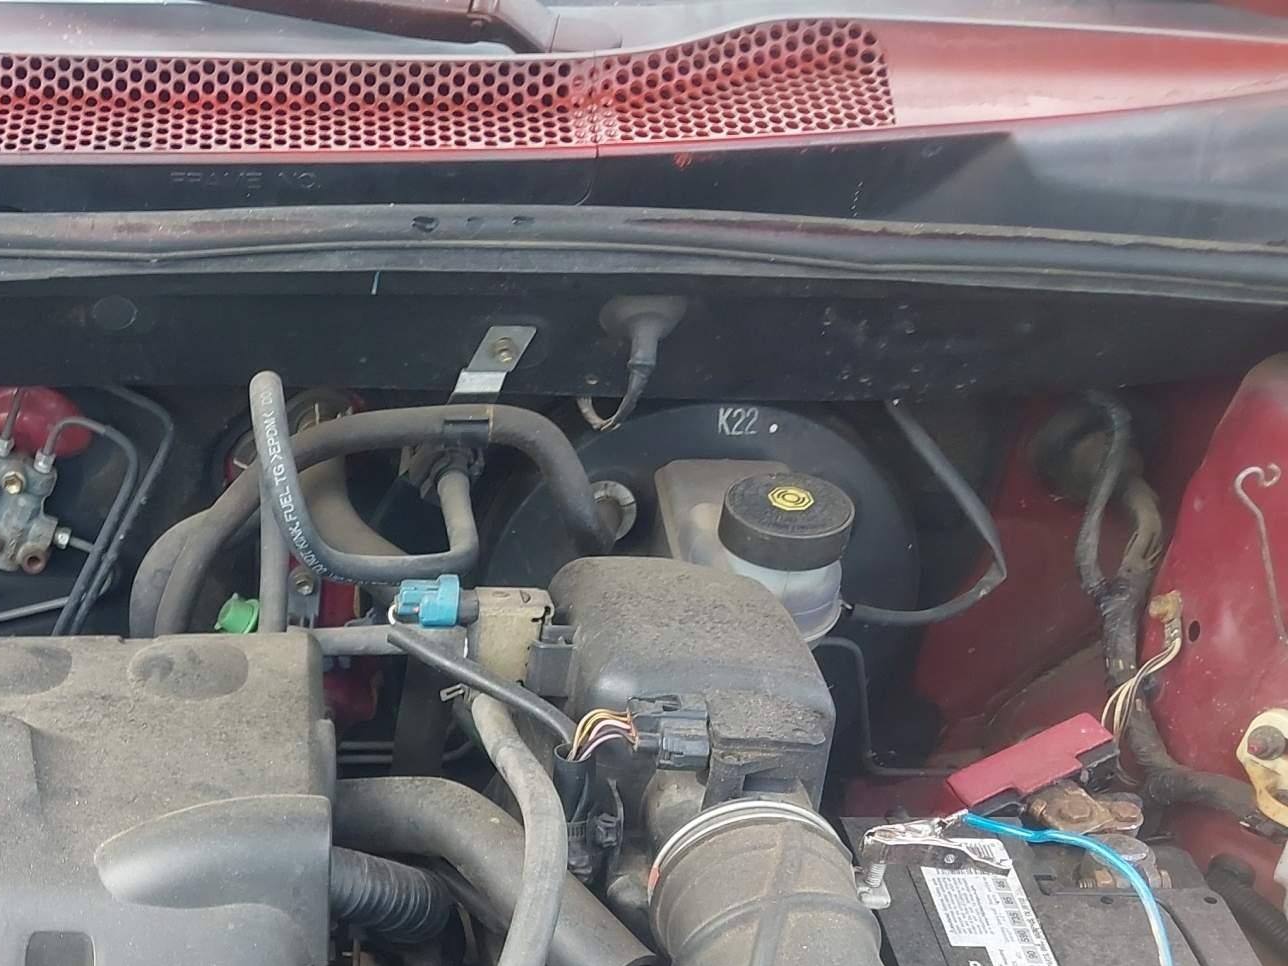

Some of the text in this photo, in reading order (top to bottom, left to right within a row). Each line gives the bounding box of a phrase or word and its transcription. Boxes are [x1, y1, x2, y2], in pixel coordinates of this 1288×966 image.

[717, 407, 759, 436] K22
[272, 464, 287, 486] TG
[279, 485, 297, 523] FUEL
